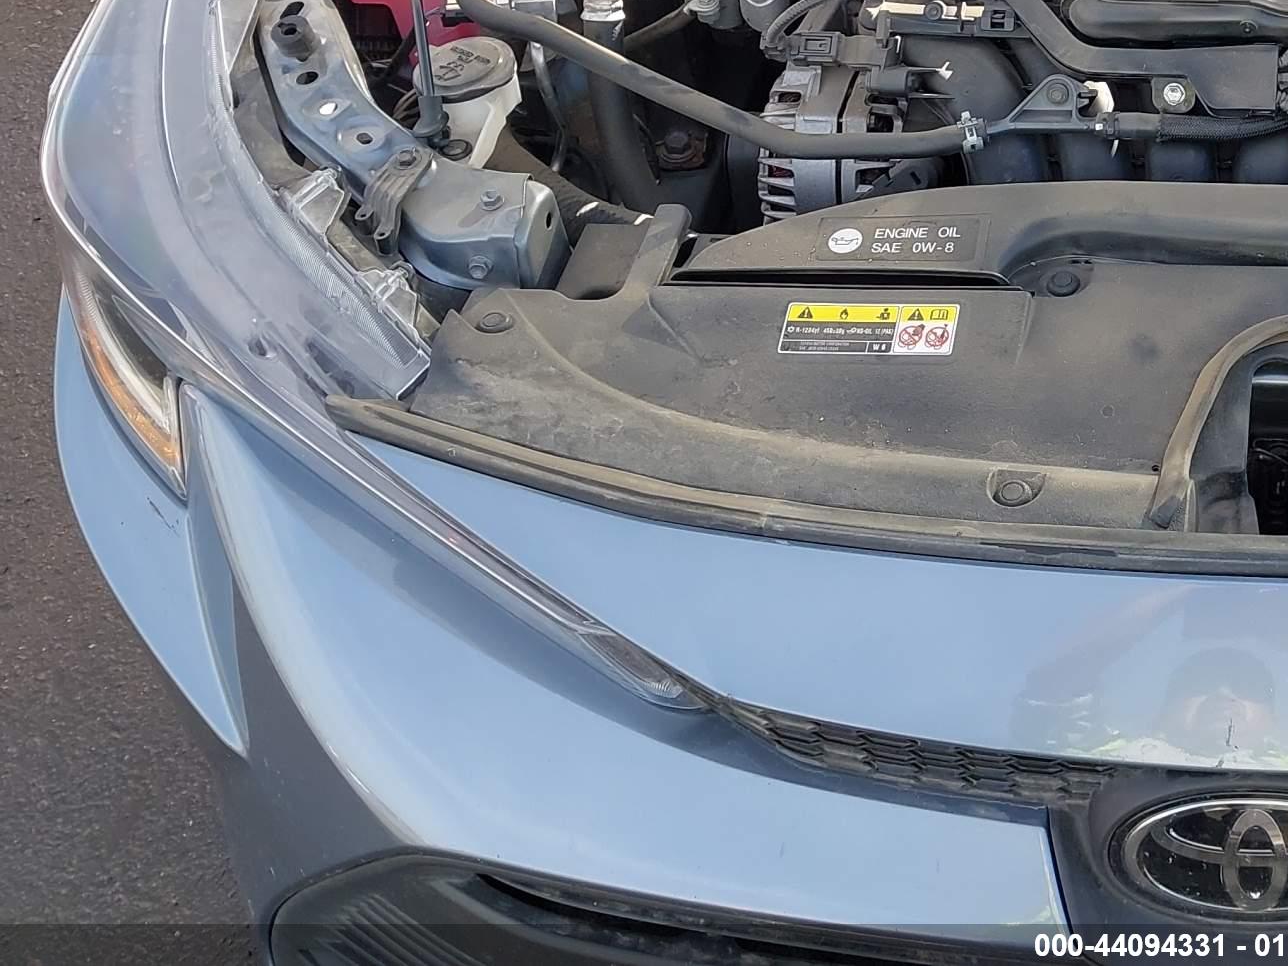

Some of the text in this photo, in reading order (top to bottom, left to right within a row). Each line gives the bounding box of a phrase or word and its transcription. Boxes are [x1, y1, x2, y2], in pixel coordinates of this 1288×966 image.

[874, 227, 961, 239] ENGINE OIL
[871, 242, 955, 253] SAE 0W-8
